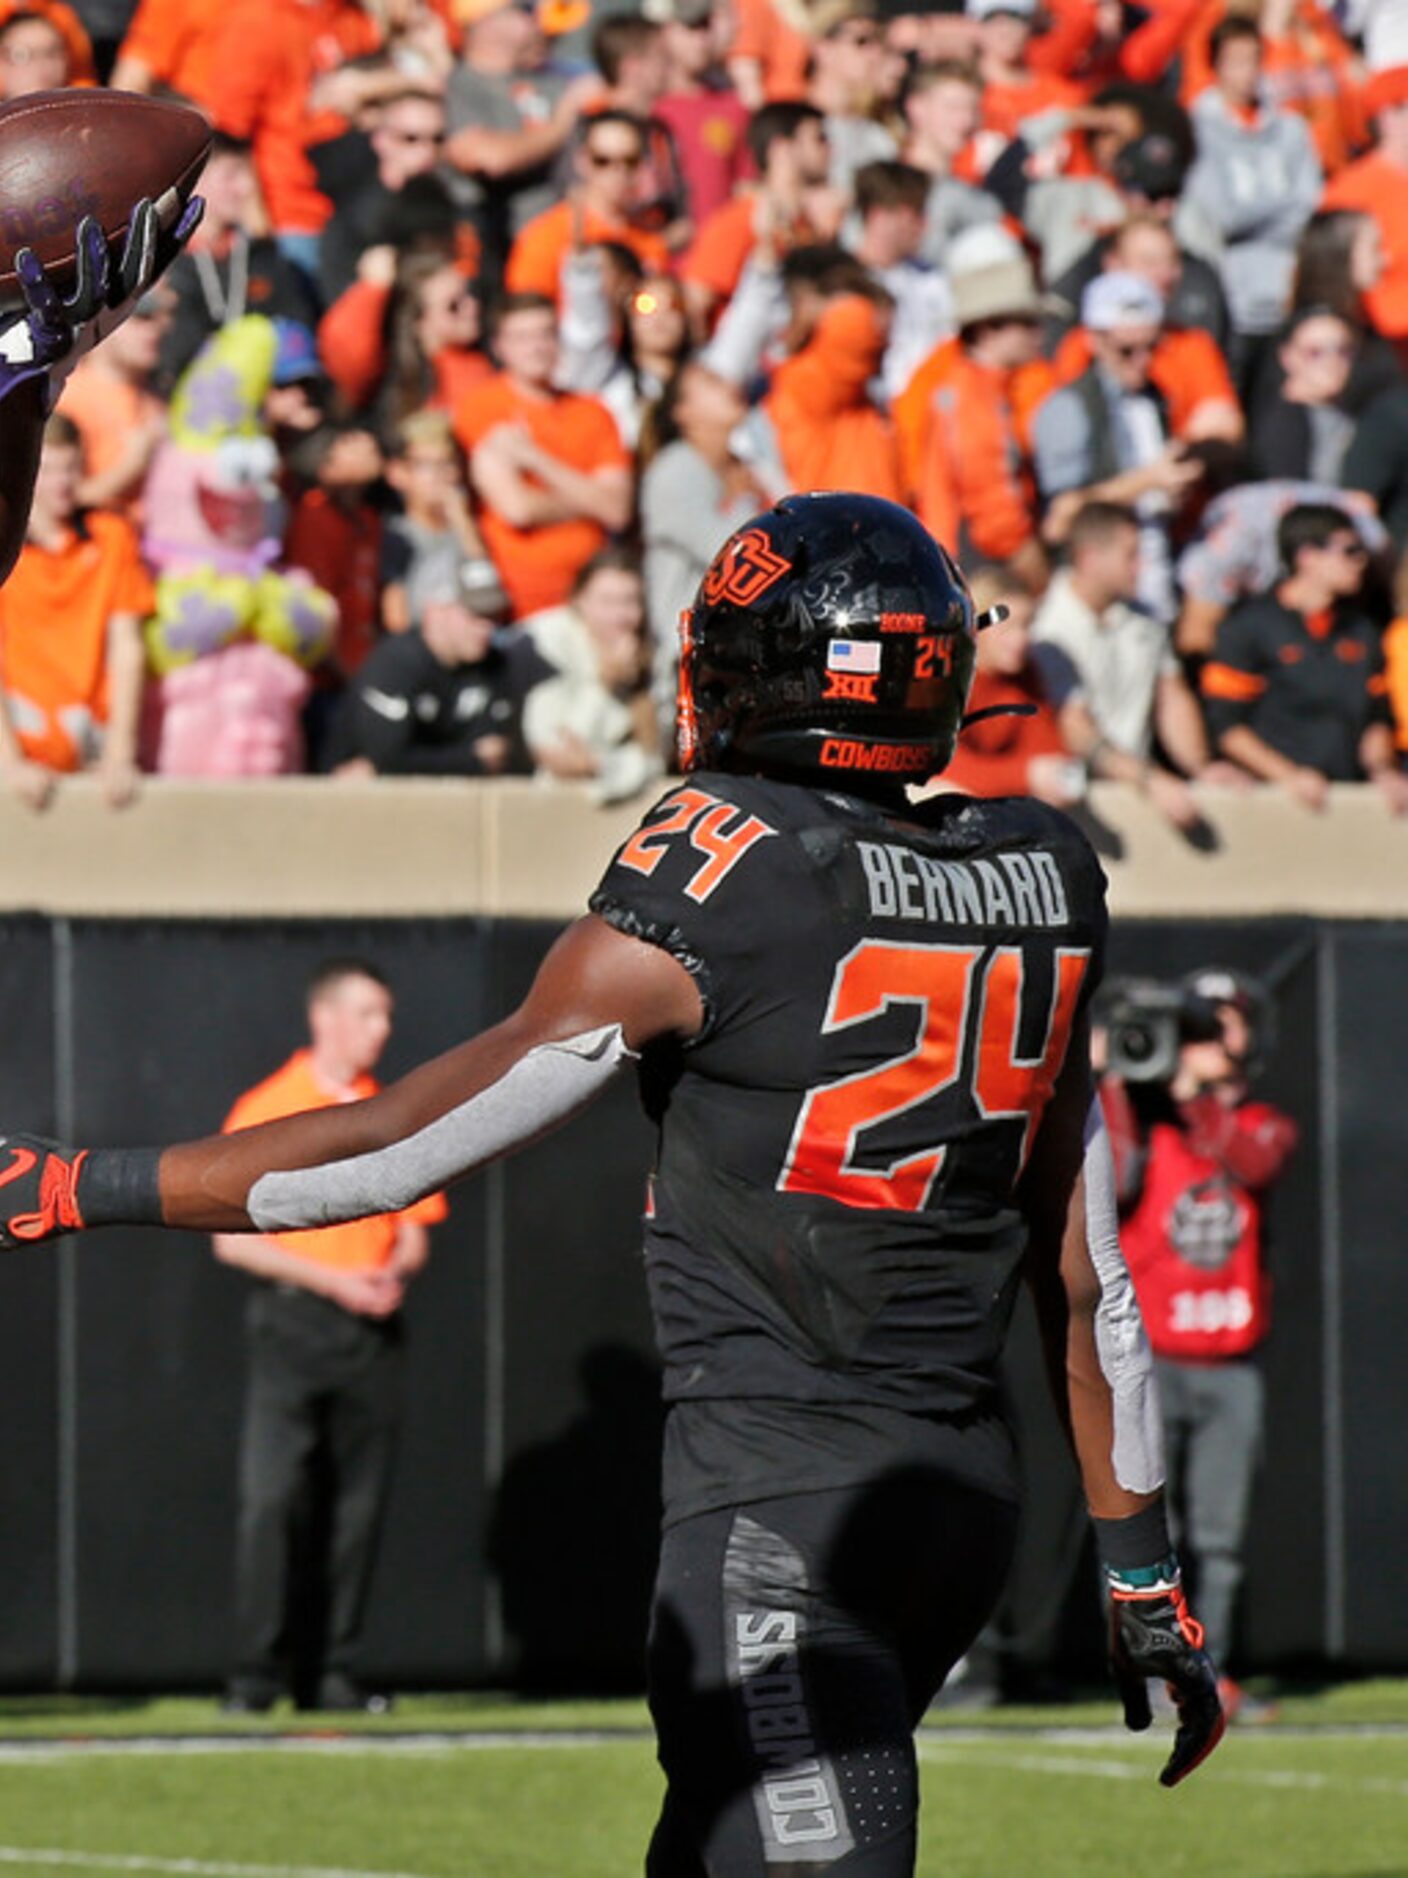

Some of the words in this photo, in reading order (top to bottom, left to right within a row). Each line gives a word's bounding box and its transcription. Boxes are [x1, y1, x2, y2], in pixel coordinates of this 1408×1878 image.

[821, 669, 881, 703] XII
[914, 636, 955, 679] 24
[819, 737, 933, 772] COWBOYS
[617, 787, 779, 904] 24
[856, 840, 1070, 928] BERNARD
[776, 938, 1092, 1212] 24
[736, 1611, 839, 1845] COWBOYS
